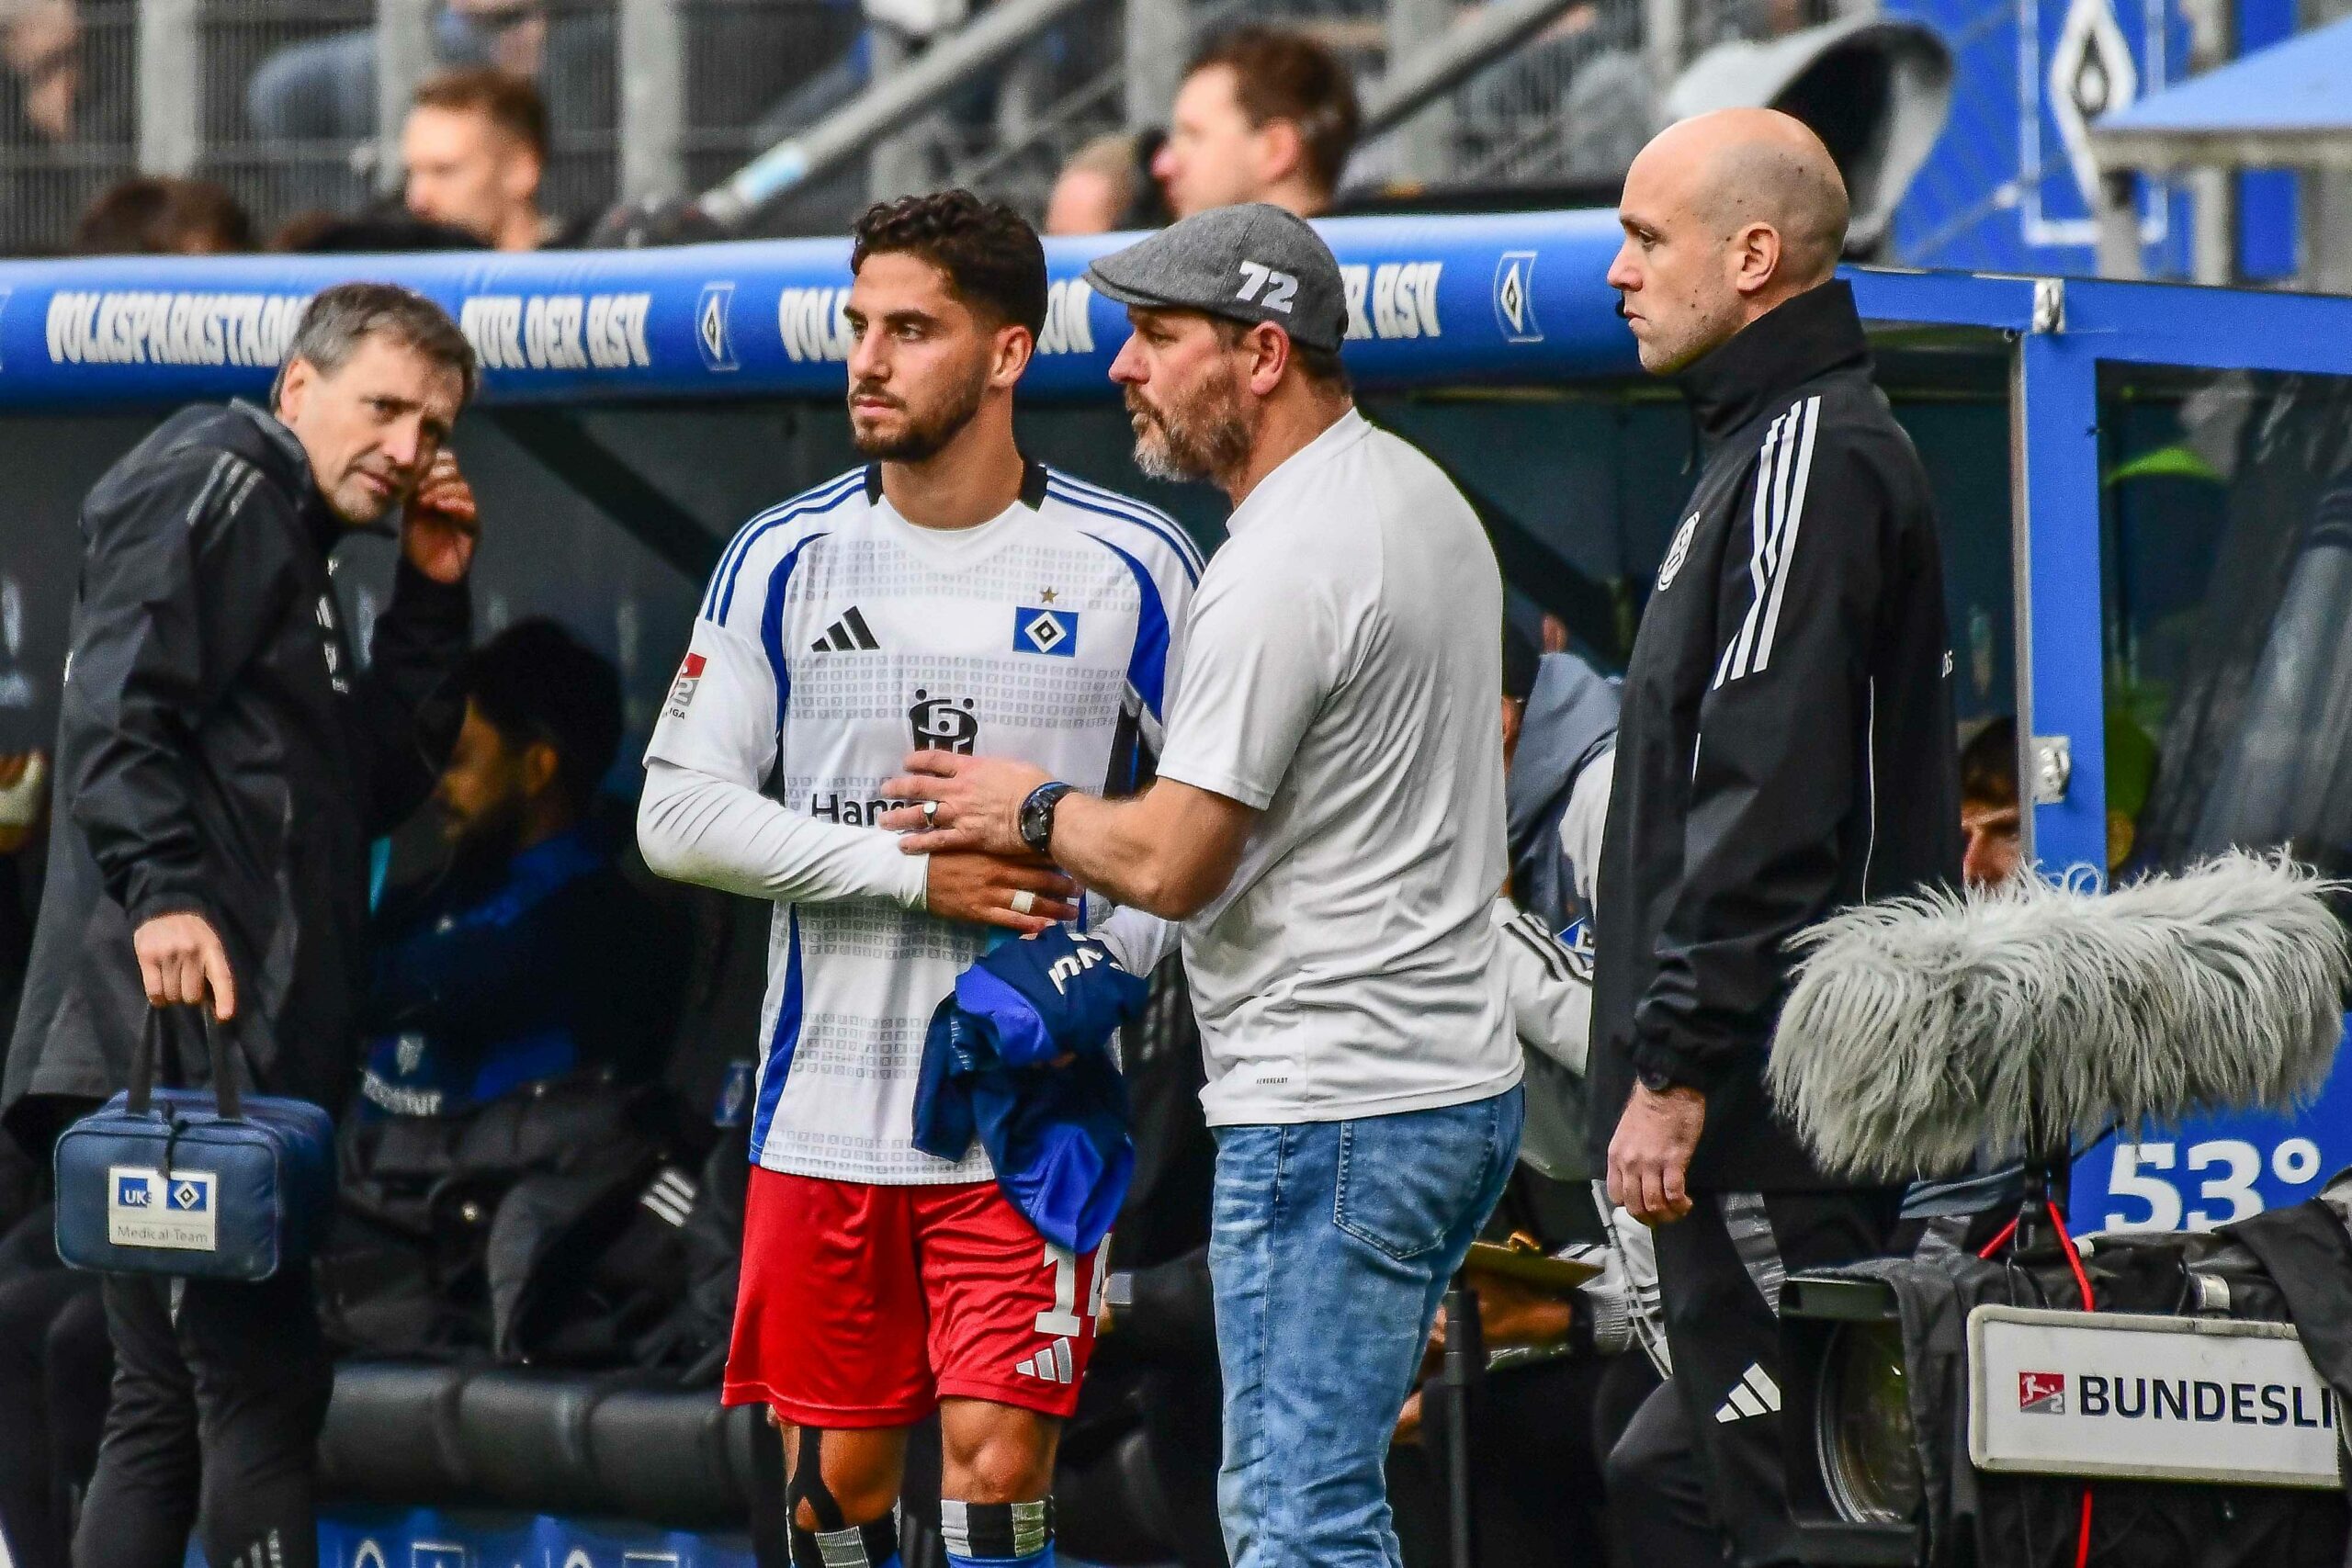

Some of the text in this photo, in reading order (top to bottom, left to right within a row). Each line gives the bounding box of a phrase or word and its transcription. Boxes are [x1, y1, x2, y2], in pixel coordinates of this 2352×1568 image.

[1235, 260, 1299, 314] 72
[1373, 262, 1443, 339] HSV
[525, 295, 588, 369] DER
[586, 293, 650, 367] HSV
[118, 1224, 208, 1244] Medical Team
[2079, 1375, 2333, 1428] BUNDESLI
